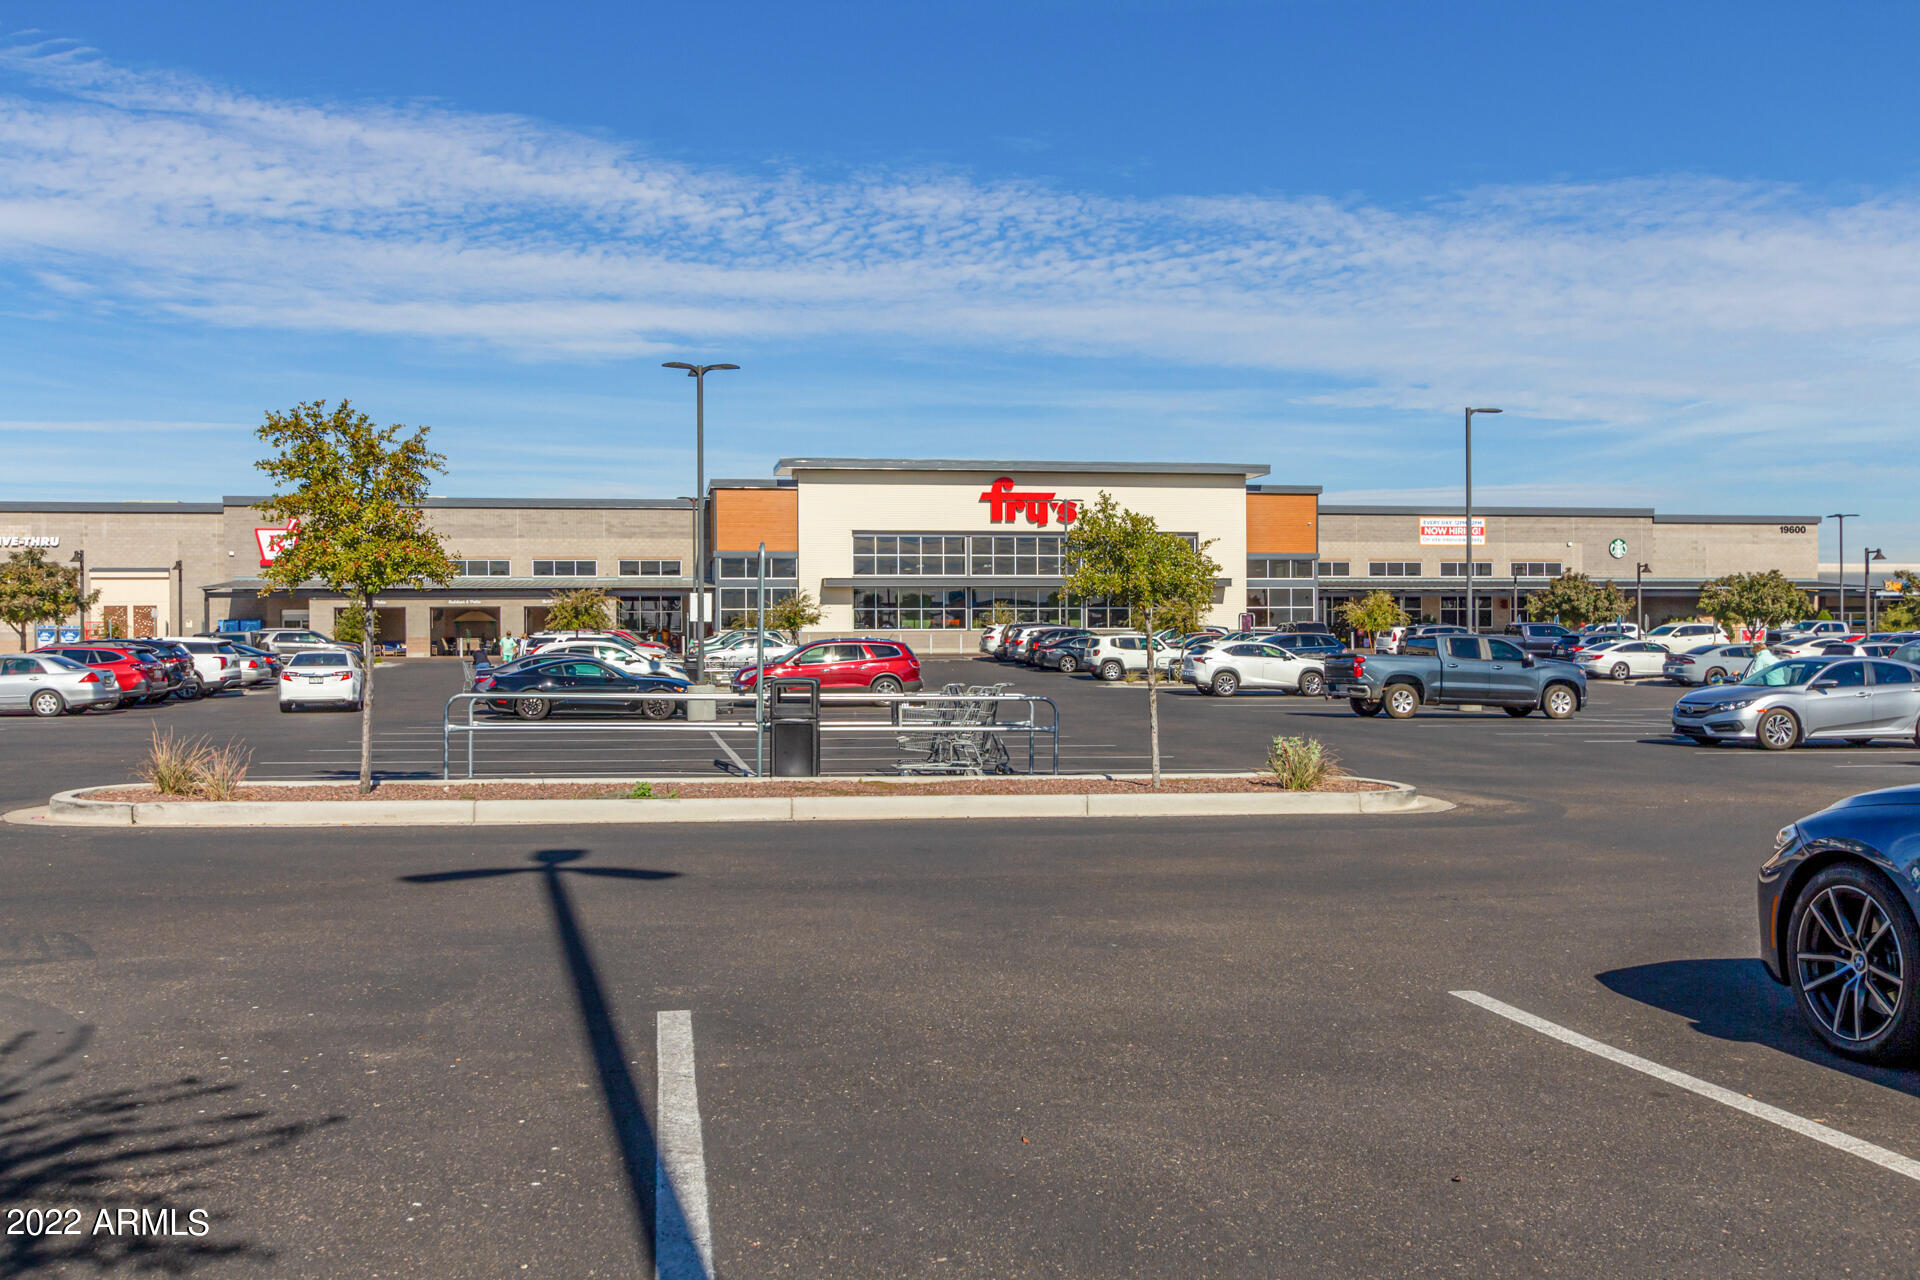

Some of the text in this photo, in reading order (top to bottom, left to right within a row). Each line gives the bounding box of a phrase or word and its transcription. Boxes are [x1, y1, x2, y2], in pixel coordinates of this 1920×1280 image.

[979, 477, 1079, 527] fry's
[1424, 527, 1481, 535] NOW HIRIG!
